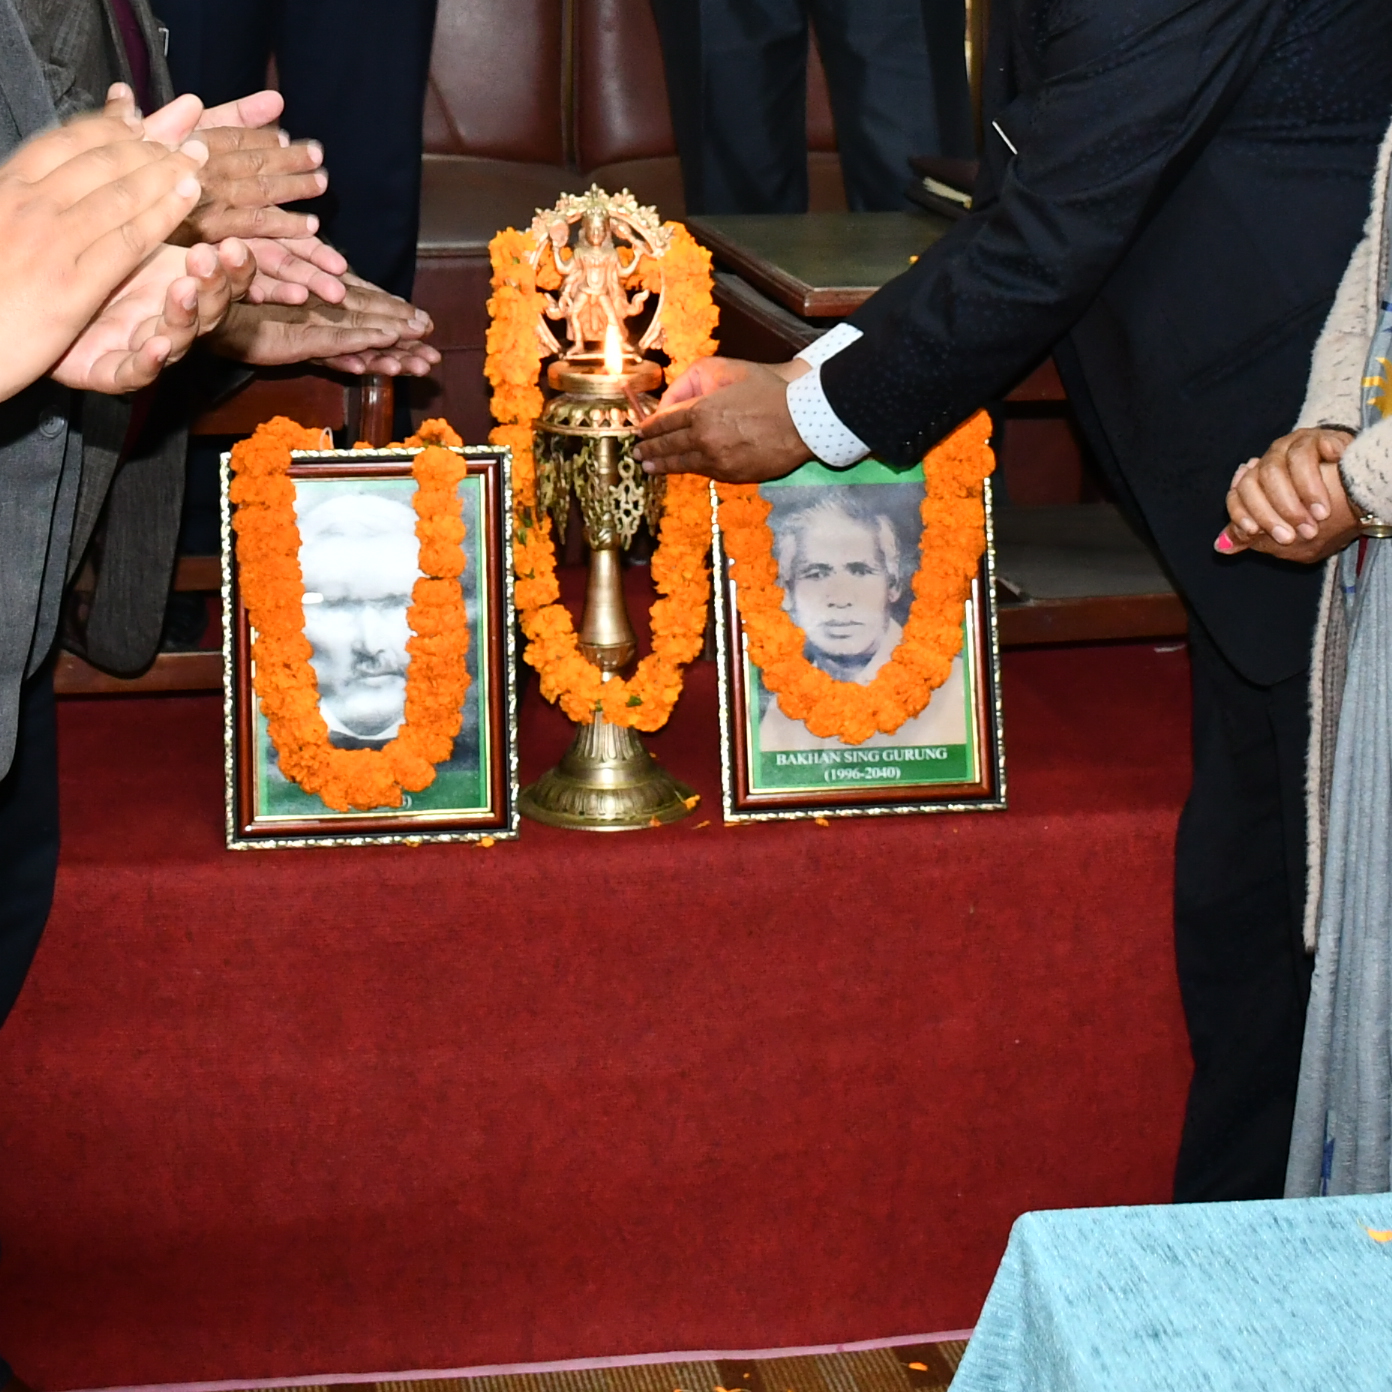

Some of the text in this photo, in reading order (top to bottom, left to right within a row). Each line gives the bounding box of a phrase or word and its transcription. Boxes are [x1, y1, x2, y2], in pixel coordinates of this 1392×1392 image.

[776, 747, 949, 766] BAKHAN SING GURUNG
[824, 766, 901, 783] (1996-2040)
